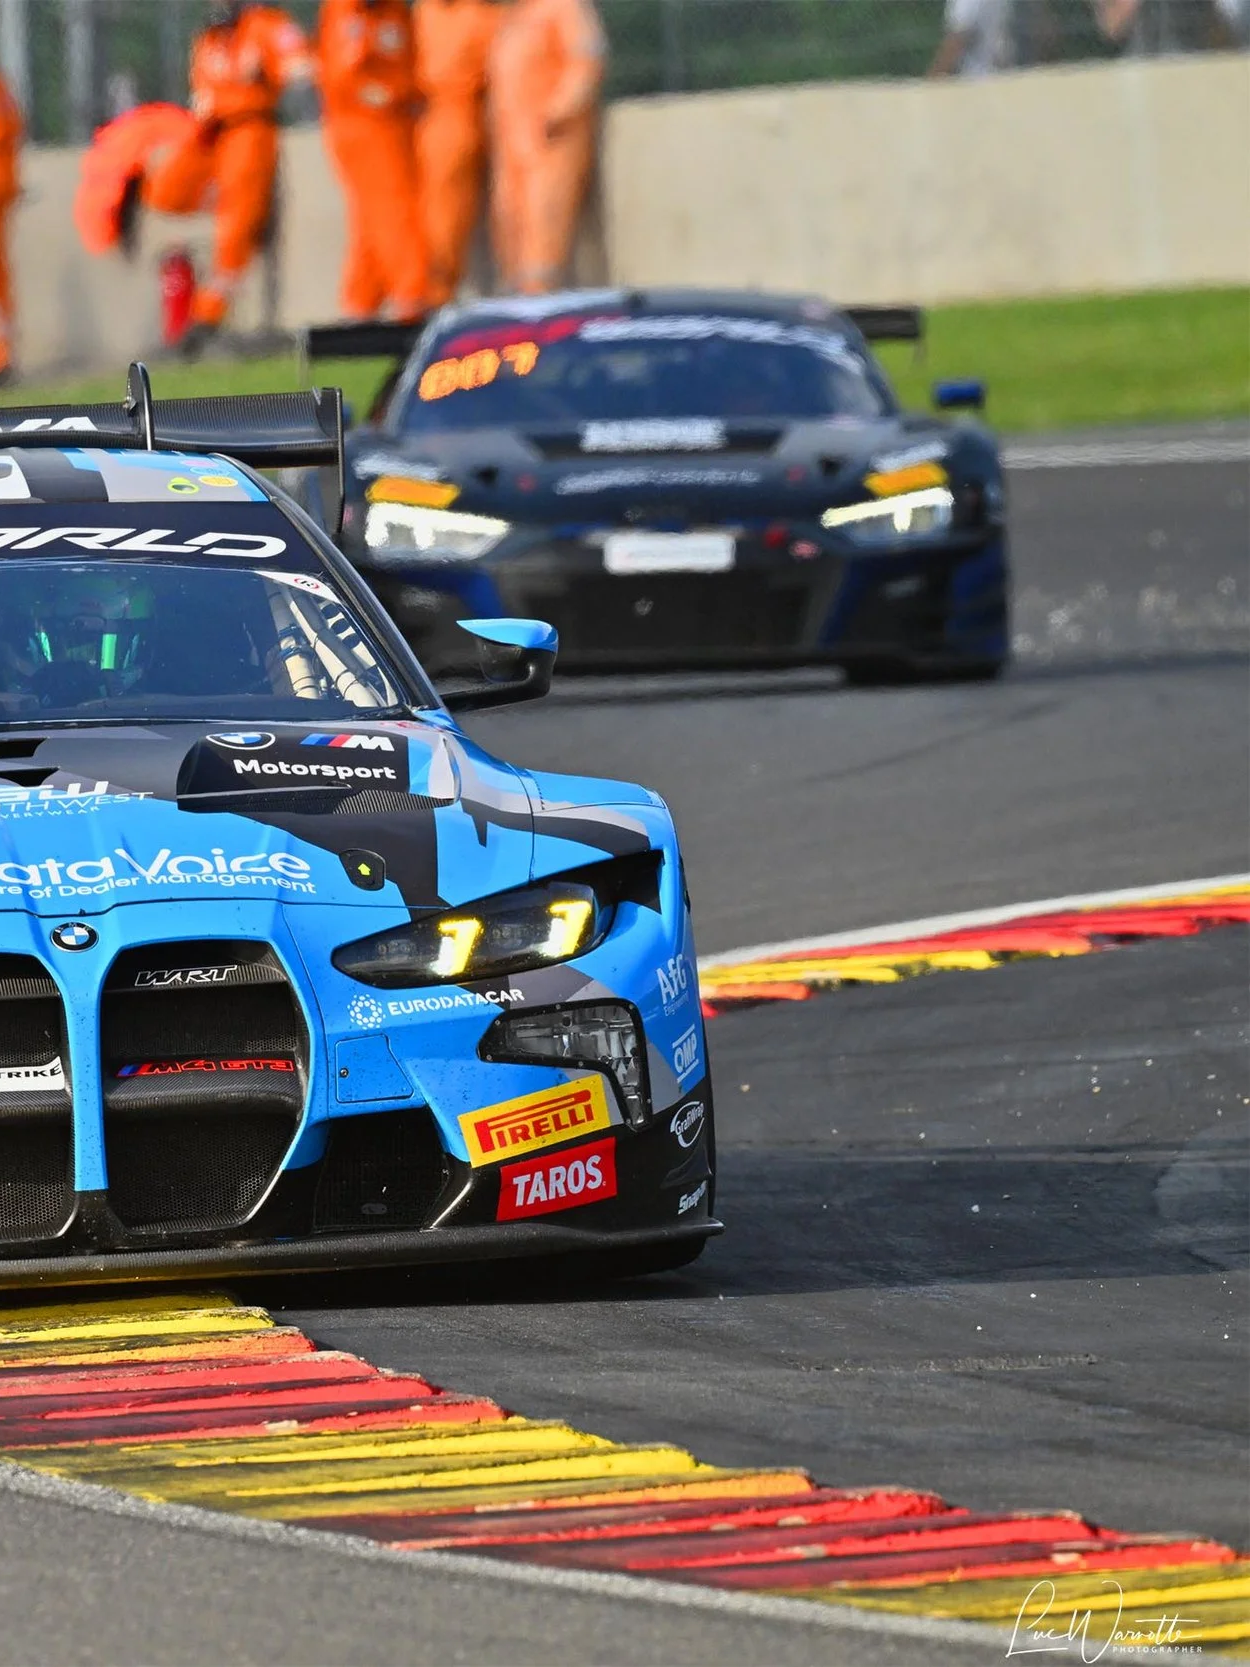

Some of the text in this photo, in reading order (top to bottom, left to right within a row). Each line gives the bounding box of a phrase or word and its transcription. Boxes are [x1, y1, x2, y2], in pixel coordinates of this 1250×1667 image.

[233, 759, 397, 780] Motorsport
[55, 792, 154, 809] WEST
[28, 886, 53, 900] of
[59, 875, 140, 898] Dealer
[148, 872, 317, 895] Management
[134, 964, 238, 987] WRT
[387, 988, 525, 1017] EURODATACAR
[673, 1032, 698, 1074] OMP
[474, 1089, 595, 1154] PIRELLI
[512, 1154, 603, 1207] TAROS
